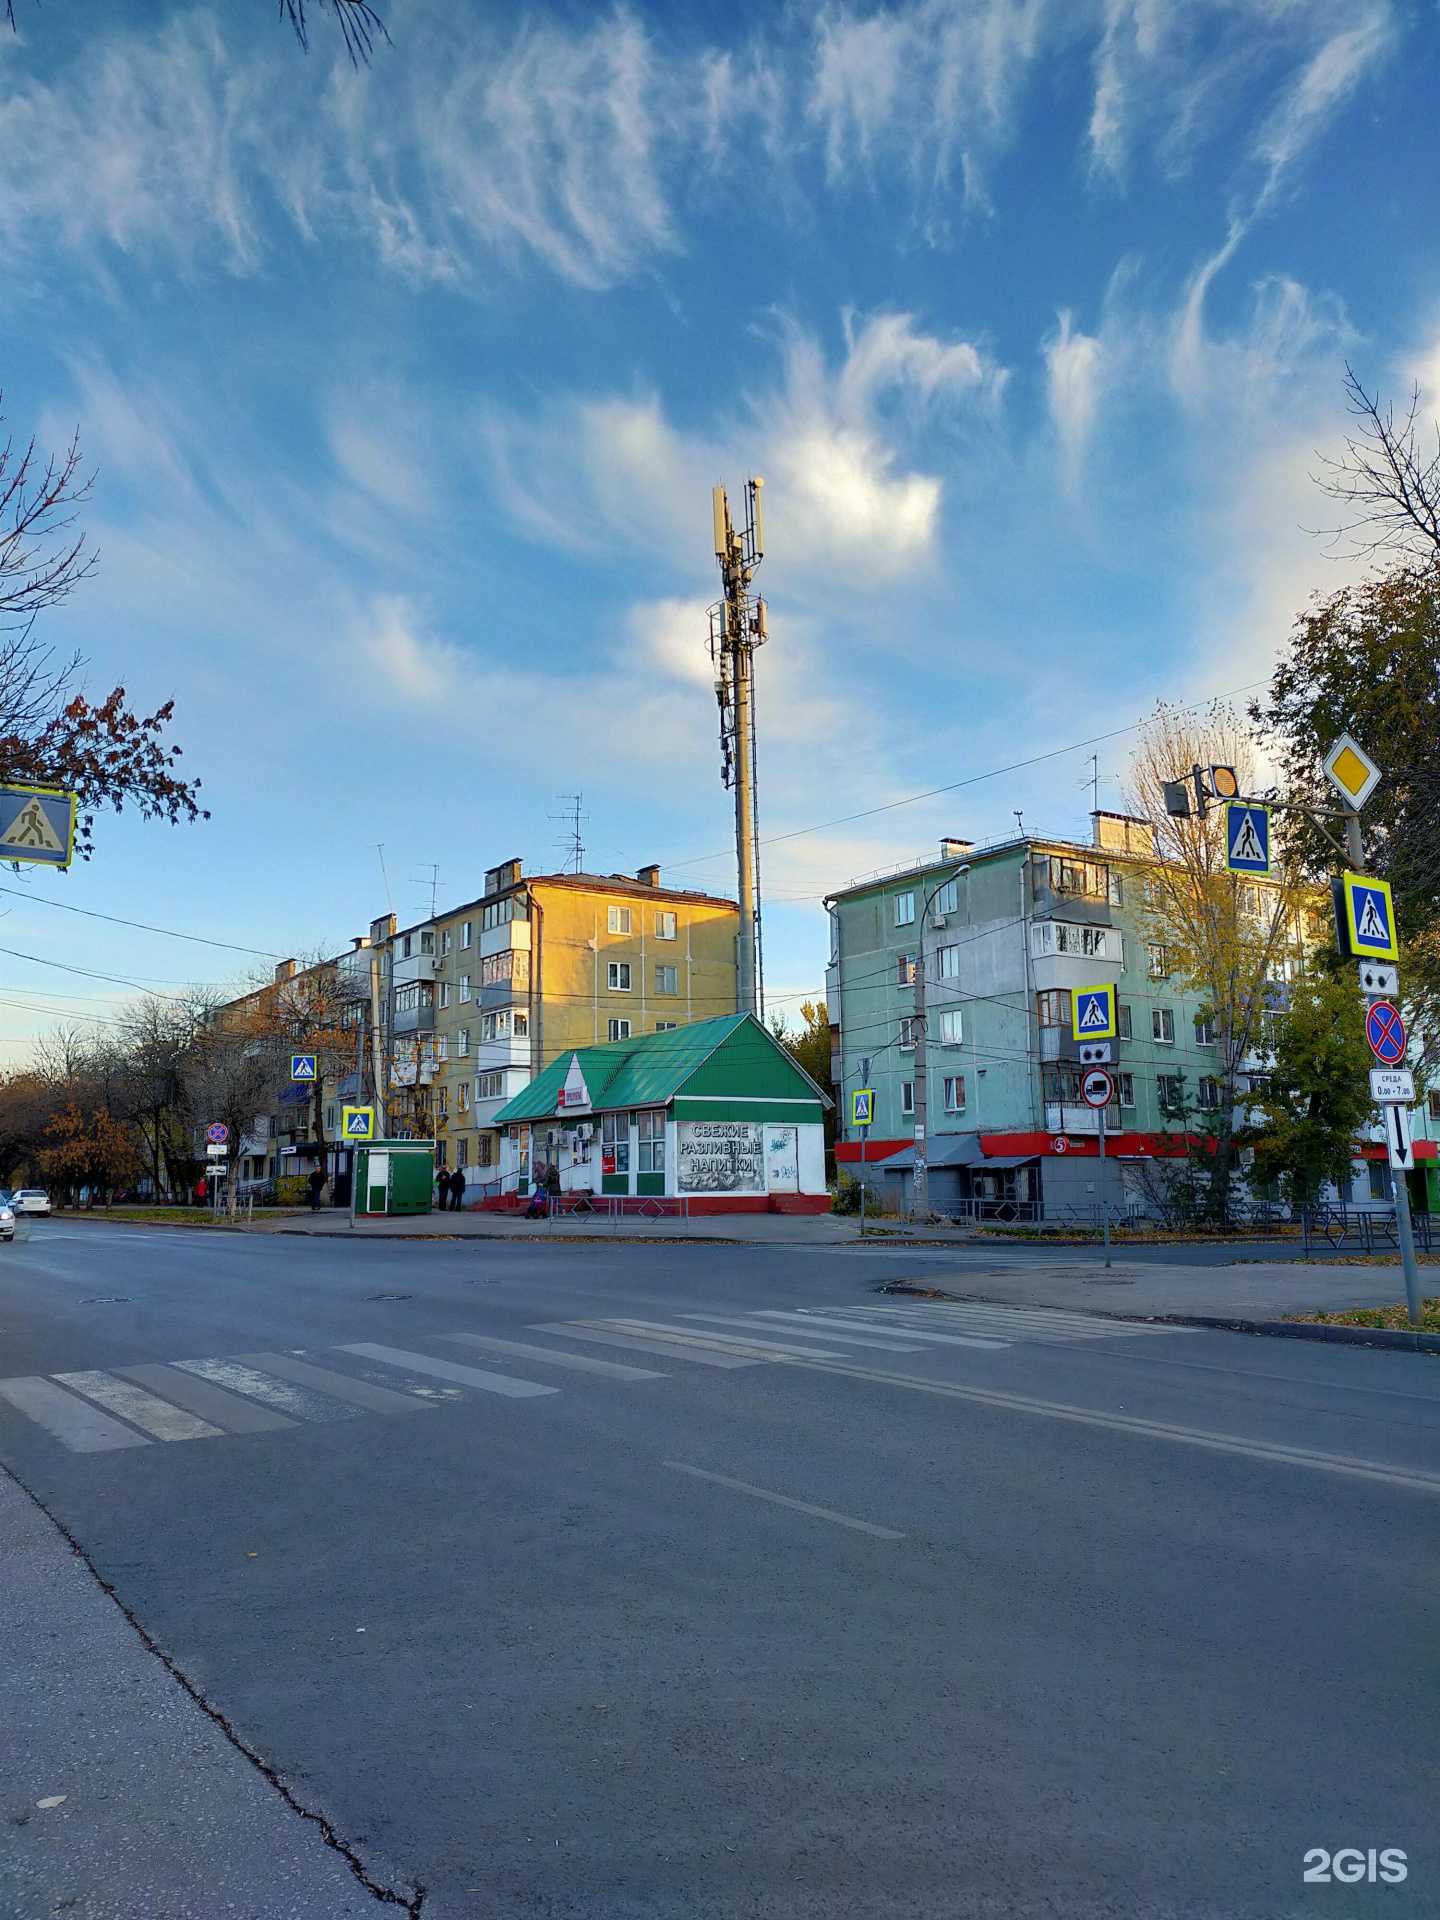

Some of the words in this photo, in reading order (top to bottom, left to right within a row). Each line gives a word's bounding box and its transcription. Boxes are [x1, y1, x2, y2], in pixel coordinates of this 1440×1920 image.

[1381, 1075, 1402, 1083] СРЕДА
[692, 1126, 749, 1138] СВЕЖИЕ
[680, 1141, 762, 1155] РАЗЛИВНЫЕ
[691, 1158, 753, 1172] НАПИТКИ
